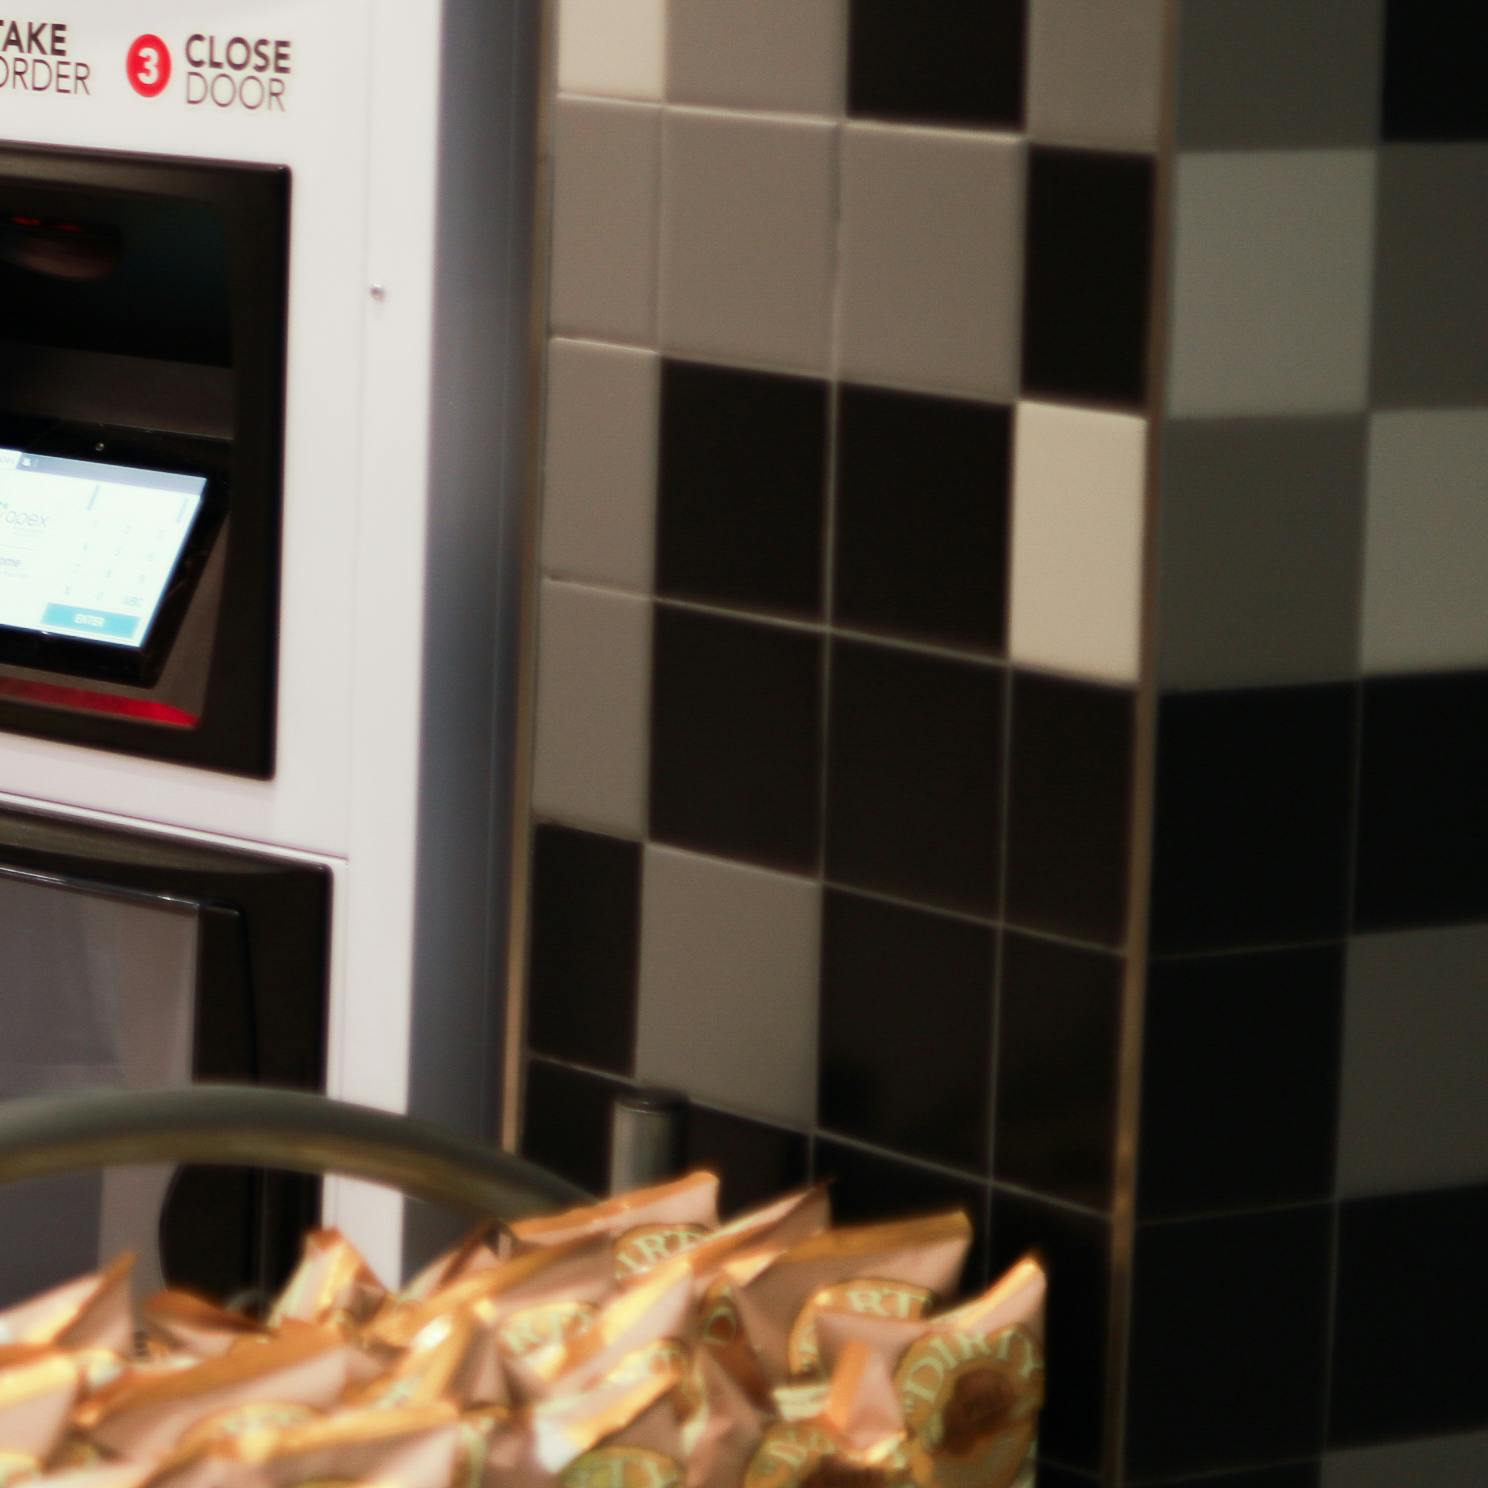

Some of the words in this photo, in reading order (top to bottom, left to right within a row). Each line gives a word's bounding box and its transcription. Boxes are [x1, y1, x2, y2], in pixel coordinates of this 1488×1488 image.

[137, 47, 159, 85] 3
[185, 34, 291, 74] CLOSE
[185, 72, 286, 112] DOOR
